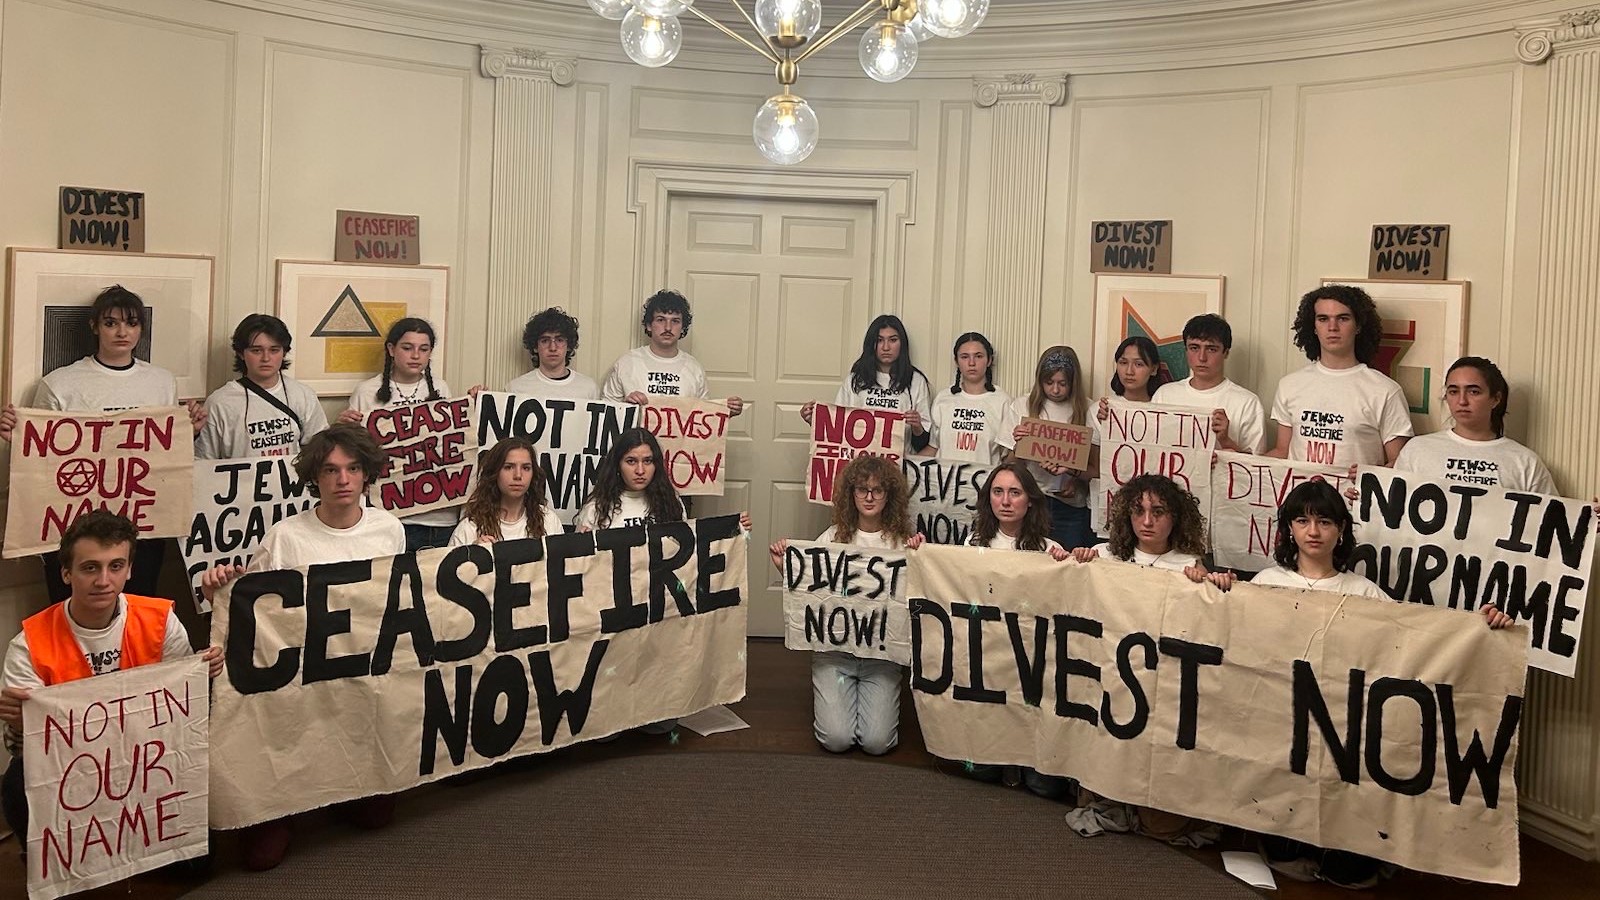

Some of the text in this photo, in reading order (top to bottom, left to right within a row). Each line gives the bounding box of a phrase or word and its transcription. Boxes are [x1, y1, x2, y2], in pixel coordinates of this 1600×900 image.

[63, 187, 144, 220] DIVEST
[69, 218, 129, 251] NOW!
[344, 216, 417, 237] CEASEFIRE
[1095, 221, 1168, 246] DIVEST
[1374, 225, 1446, 250] DIVEST
[354, 240, 407, 259] NOW!
[1104, 245, 1155, 271] NOW!
[1377, 249, 1430, 275] NOW!
[648, 372, 673, 382] JEWS
[648, 385, 680, 395] CEASEFIRE
[866, 397, 899, 409] CEASEFIRE
[953, 409, 981, 418] JEWS
[1301, 410, 1335, 424] JEWS
[23, 416, 174, 457] NOT IN
[248, 418, 282, 435] JEWS
[367, 398, 470, 445] CEASE
[478, 394, 576, 449] NOT
[644, 406, 728, 440] DIVEST
[815, 403, 905, 449] NOT
[951, 420, 985, 432] CEASEFIRE
[1109, 409, 1210, 449] NOT IN
[1300, 425, 1343, 441] CEASEFIRE
[251, 431, 294, 449] CEASEFIRE
[379, 432, 465, 478] FIRE
[956, 431, 978, 452] NOW
[1031, 441, 1077, 464] NOW!
[1306, 440, 1336, 464] NOW
[1446, 458, 1487, 471] JEWS
[213, 459, 306, 505] JEW
[381, 464, 473, 510] NOW
[540, 453, 606, 510] NAM
[903, 459, 986, 511] DIVES
[1360, 472, 1488, 540] NOT
[1495, 493, 1592, 570] IN
[786, 545, 907, 600] DIVEST
[225, 513, 741, 695] CEASEFIRE
[1448, 553, 1585, 658] NAME
[805, 604, 888, 651] NOW!
[45, 681, 190, 755] NOT IN
[420, 640, 610, 776] NOW
[909, 598, 1522, 809] DIVEST NOW
[59, 740, 173, 811] OUR
[42, 791, 189, 879] NAME
